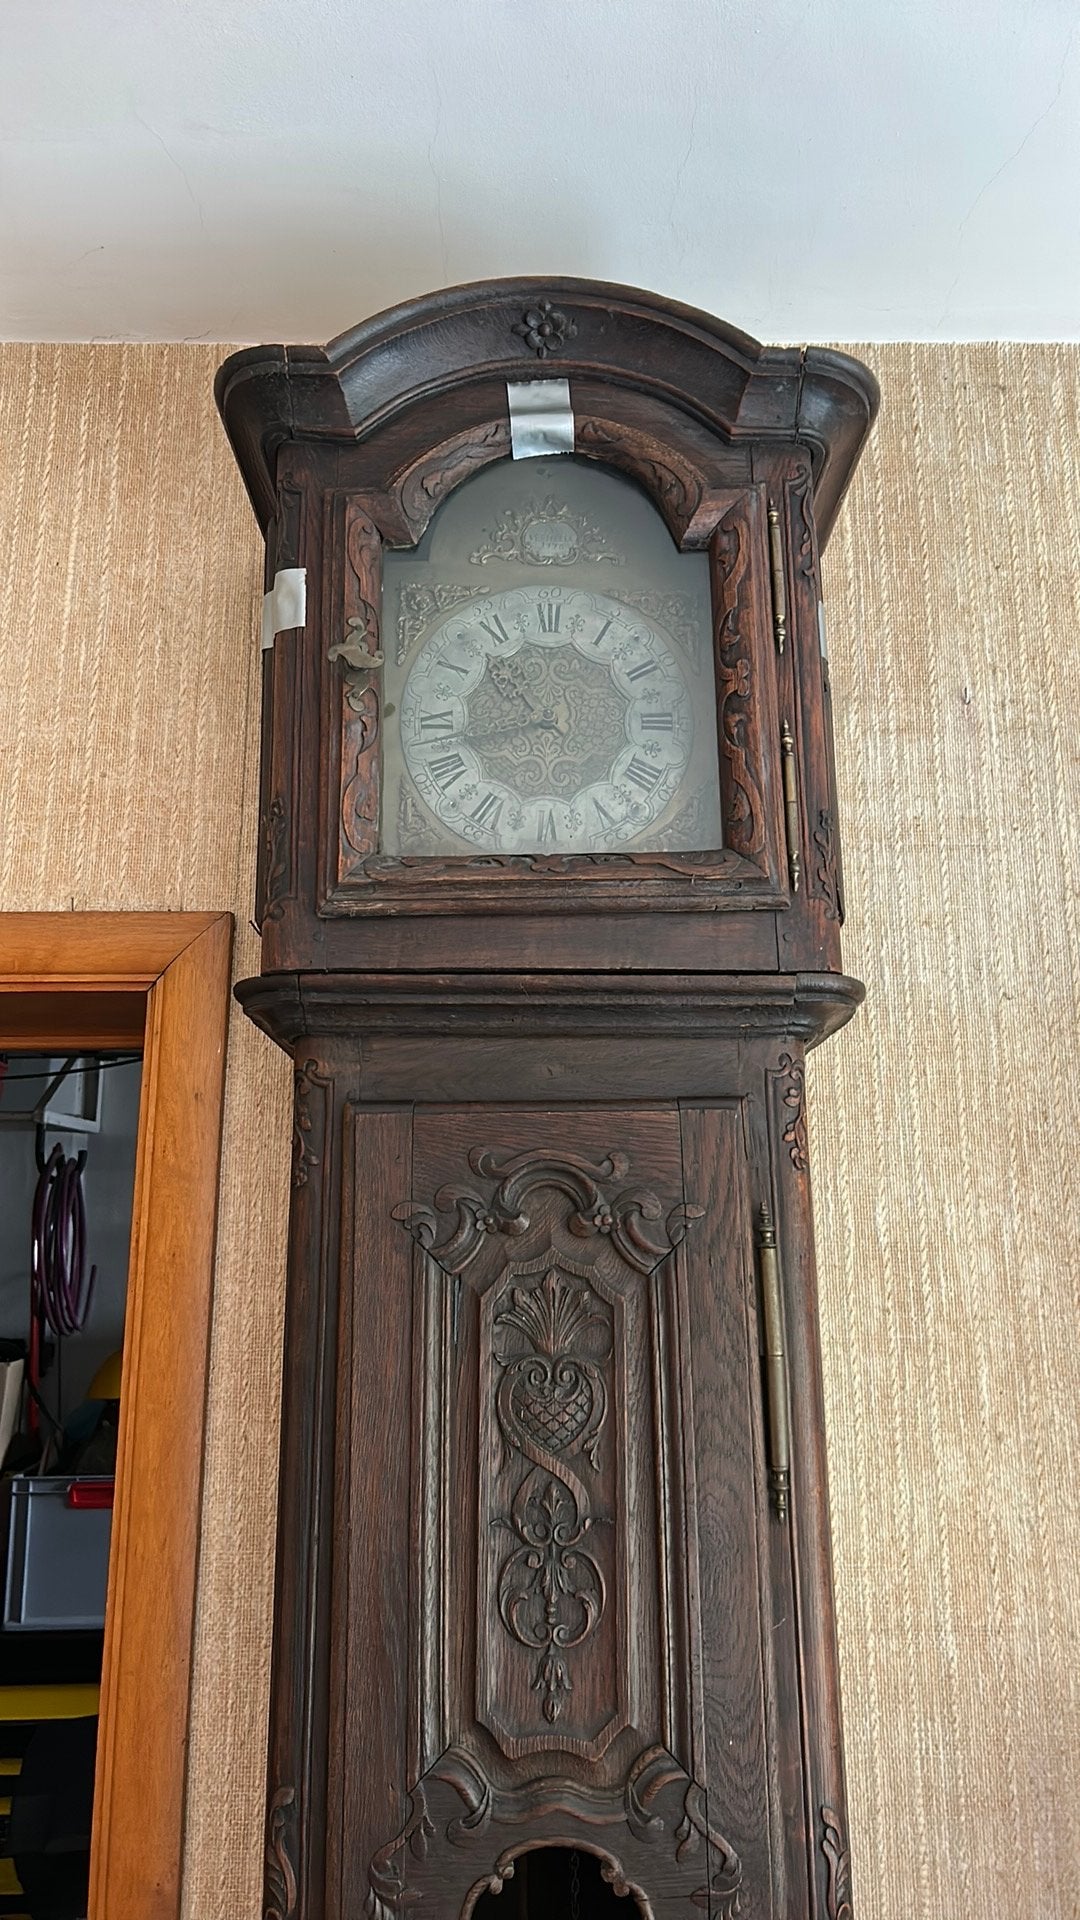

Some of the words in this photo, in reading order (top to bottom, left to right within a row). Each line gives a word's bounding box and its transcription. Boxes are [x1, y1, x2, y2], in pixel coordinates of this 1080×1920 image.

[537, 587, 562, 599] 60
[479, 613, 510, 647] XI
[536, 602, 562, 633] XII
[591, 620, 613, 647] I
[421, 641, 439, 662] 50
[659, 650, 676, 667] 10
[436, 653, 472, 681] X
[626, 658, 657, 683] II
[402, 705, 415, 729] 45
[420, 709, 454, 732] IX
[640, 712, 673, 731] III
[414, 773, 433, 795] 40
[428, 752, 468, 791] VIII
[624, 757, 664, 793] IIII
[658, 775, 679, 802] 20
[469, 791, 505, 830] VII
[591, 797, 616, 830] V
[536, 808, 558, 843] VI
